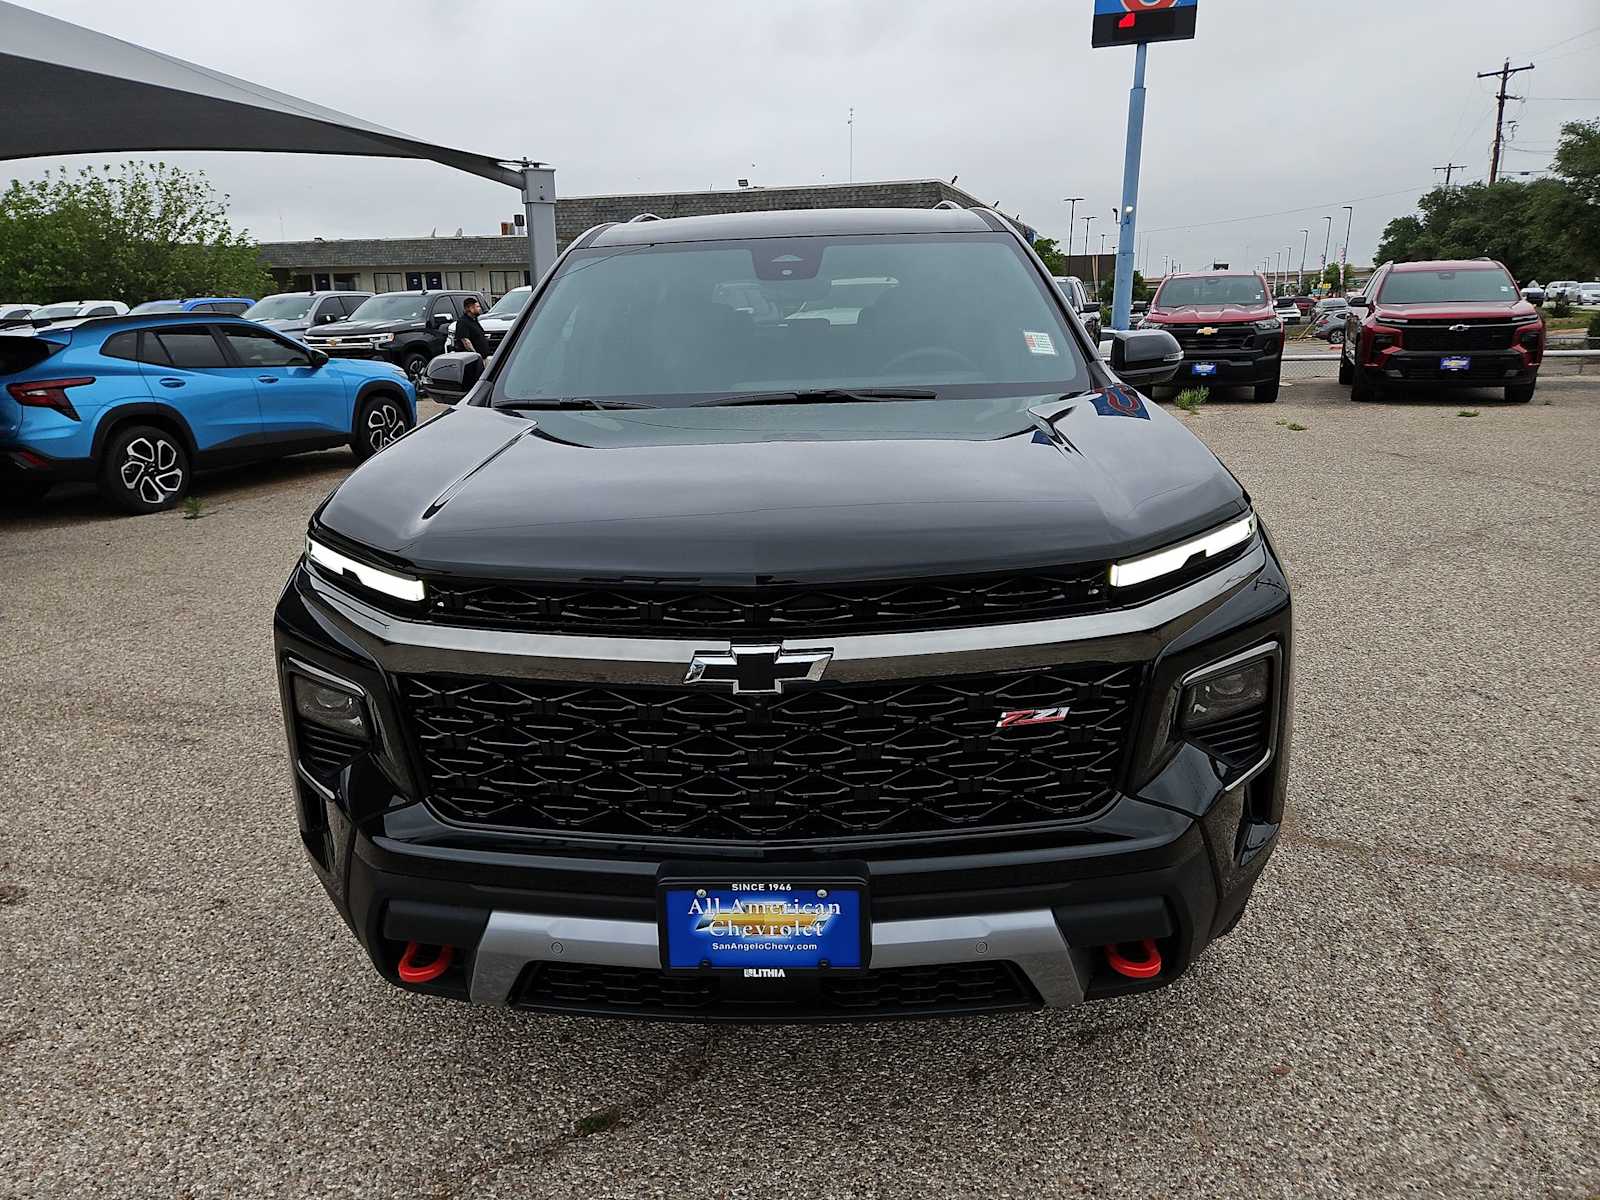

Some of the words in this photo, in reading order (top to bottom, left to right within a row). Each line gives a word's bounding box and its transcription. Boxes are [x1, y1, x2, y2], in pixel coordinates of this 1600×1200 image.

[996, 707, 1070, 728] Z71
[731, 883, 765, 892] SINCE
[768, 883, 792, 892] 1946
[688, 897, 721, 915] All
[731, 898, 841, 915] American
[709, 919, 823, 937] Chevrolet
[712, 942, 817, 951] SanAngeloChevy.com
